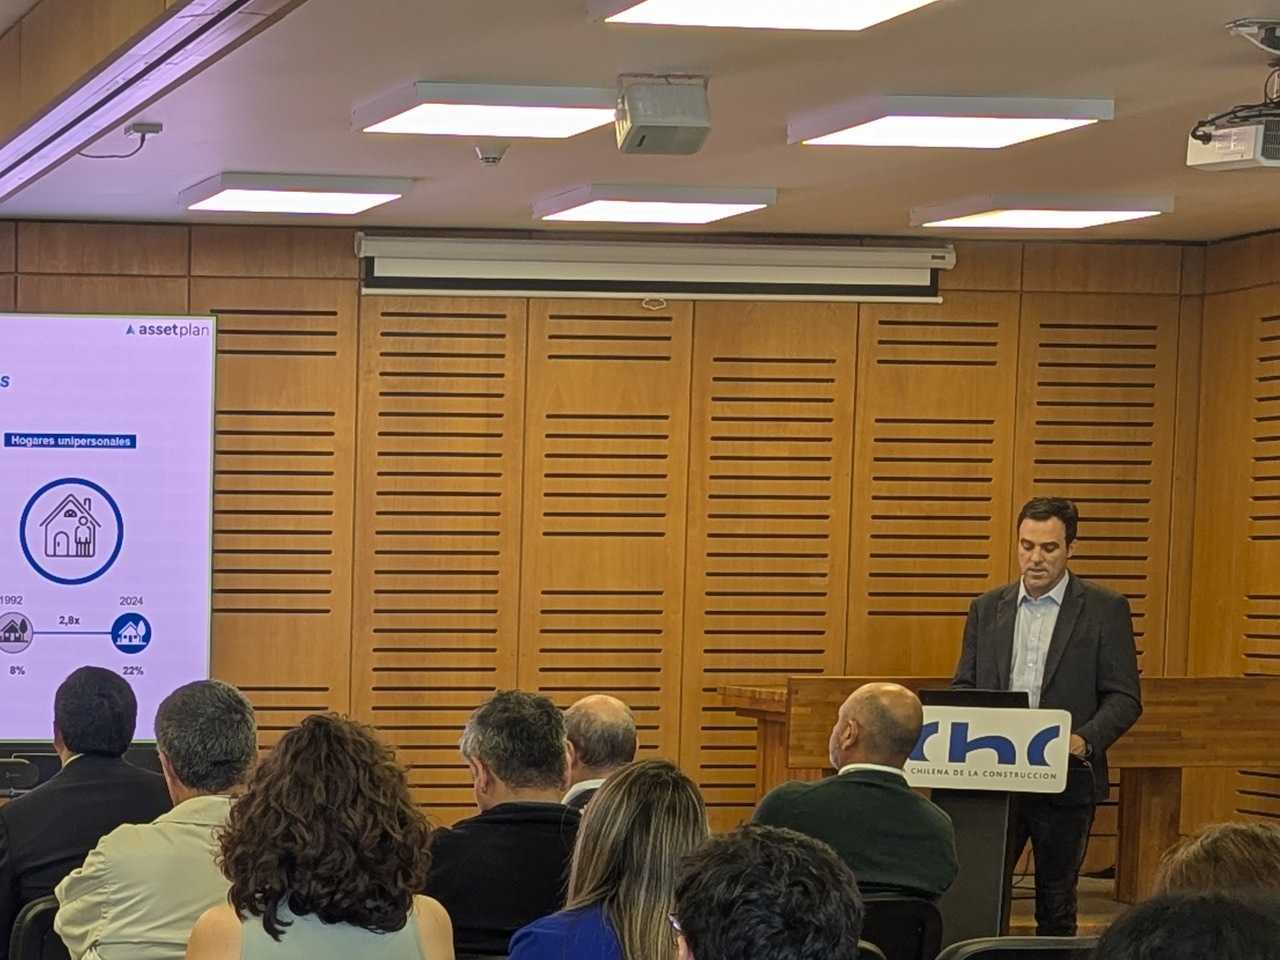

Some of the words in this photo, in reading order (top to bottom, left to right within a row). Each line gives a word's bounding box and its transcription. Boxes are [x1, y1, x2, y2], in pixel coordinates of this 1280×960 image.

[139, 323, 210, 338] assetplan
[11, 435, 55, 447] Hogares
[58, 436, 131, 448] unipersonales
[0, 595, 23, 605] 1992
[120, 596, 143, 606] 2024
[59, 616, 80, 627] 2,8x
[10, 666, 25, 675] 8%
[123, 666, 144, 676] 22%
[910, 767, 950, 776] CHILENA
[953, 769, 964, 777] DE
[982, 770, 1057, 780] CONSTRUCCION
